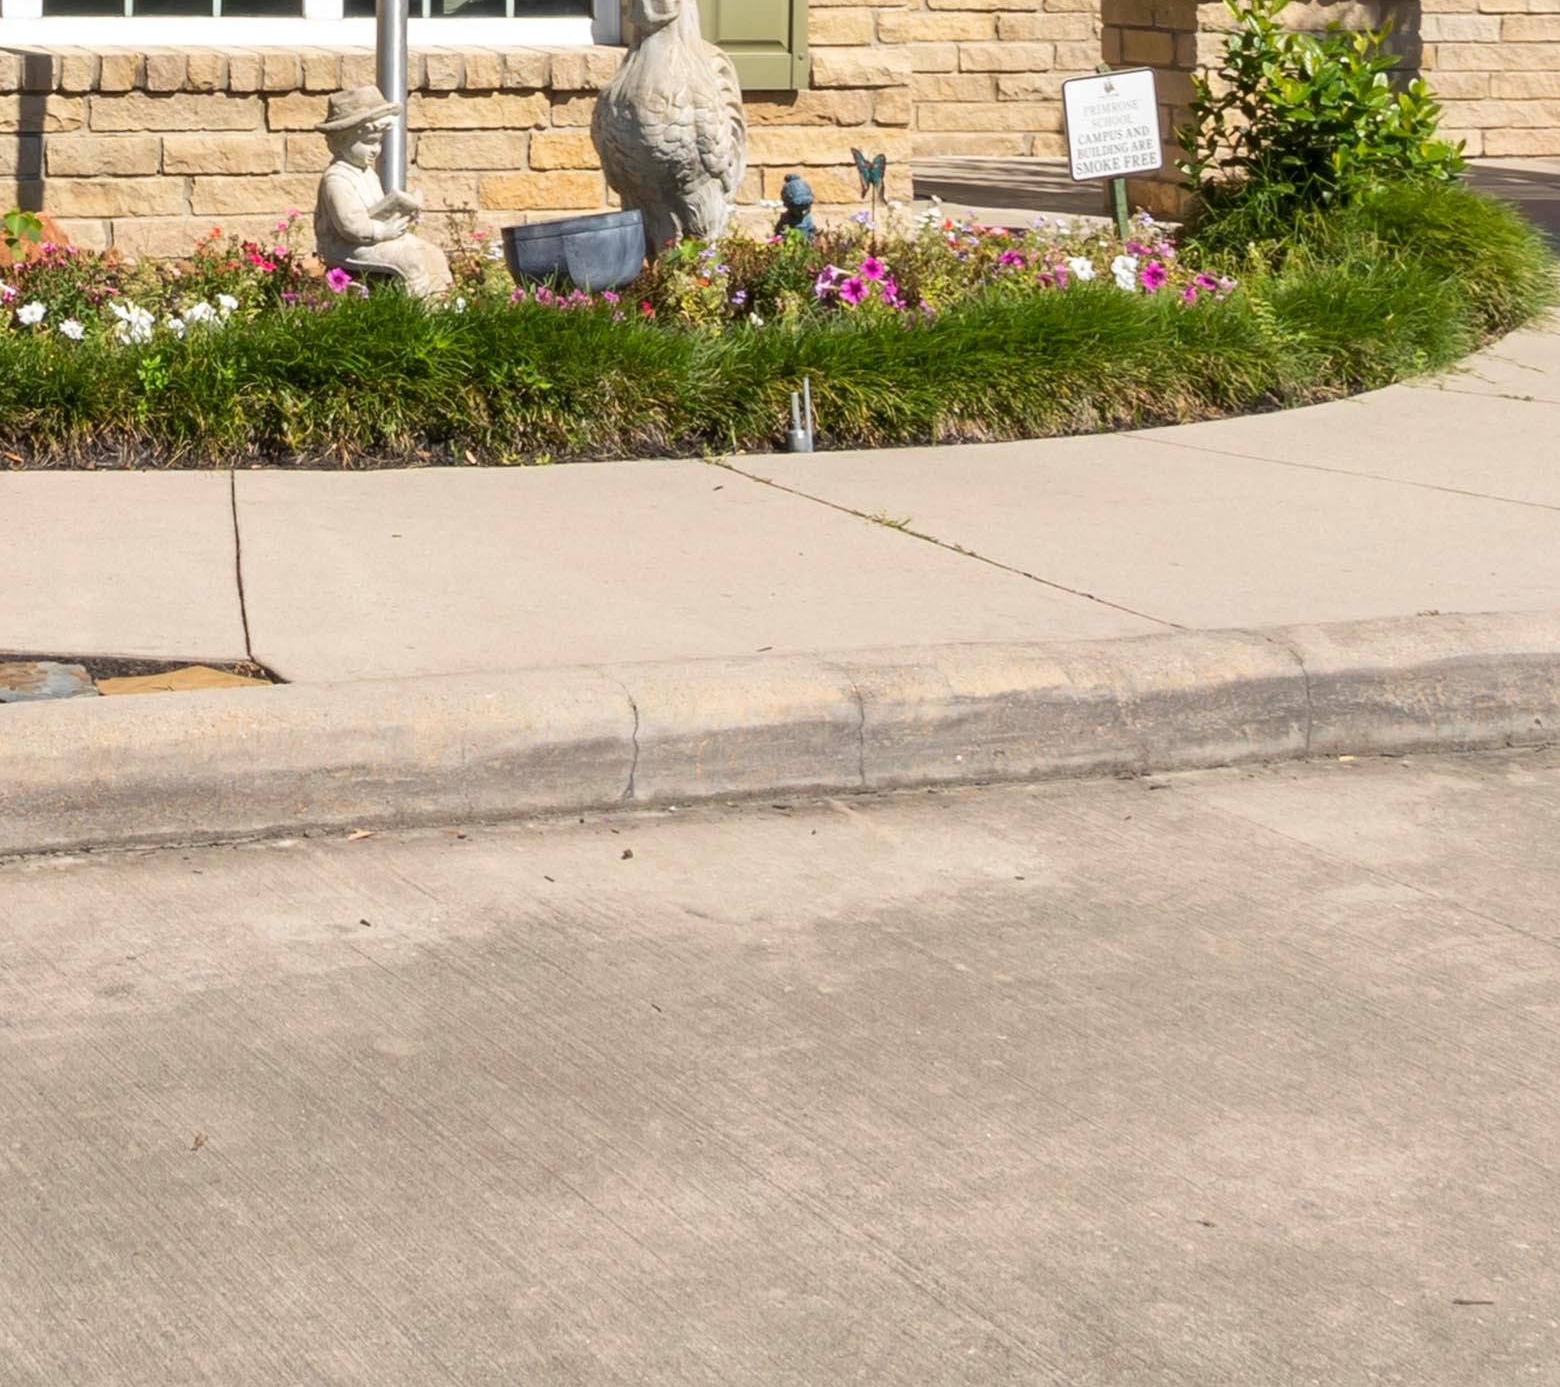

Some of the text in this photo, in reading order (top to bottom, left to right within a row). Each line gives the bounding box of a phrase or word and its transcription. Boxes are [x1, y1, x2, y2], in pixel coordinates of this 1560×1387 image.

[1083, 100, 1139, 115] PRIMROSE
[1091, 115, 1133, 128] SCHOOL
[1078, 126, 1150, 145] CAMPUS AND
[1077, 139, 1153, 159] BUILDING ARE
[1076, 152, 1157, 175] SMOKE FREE
